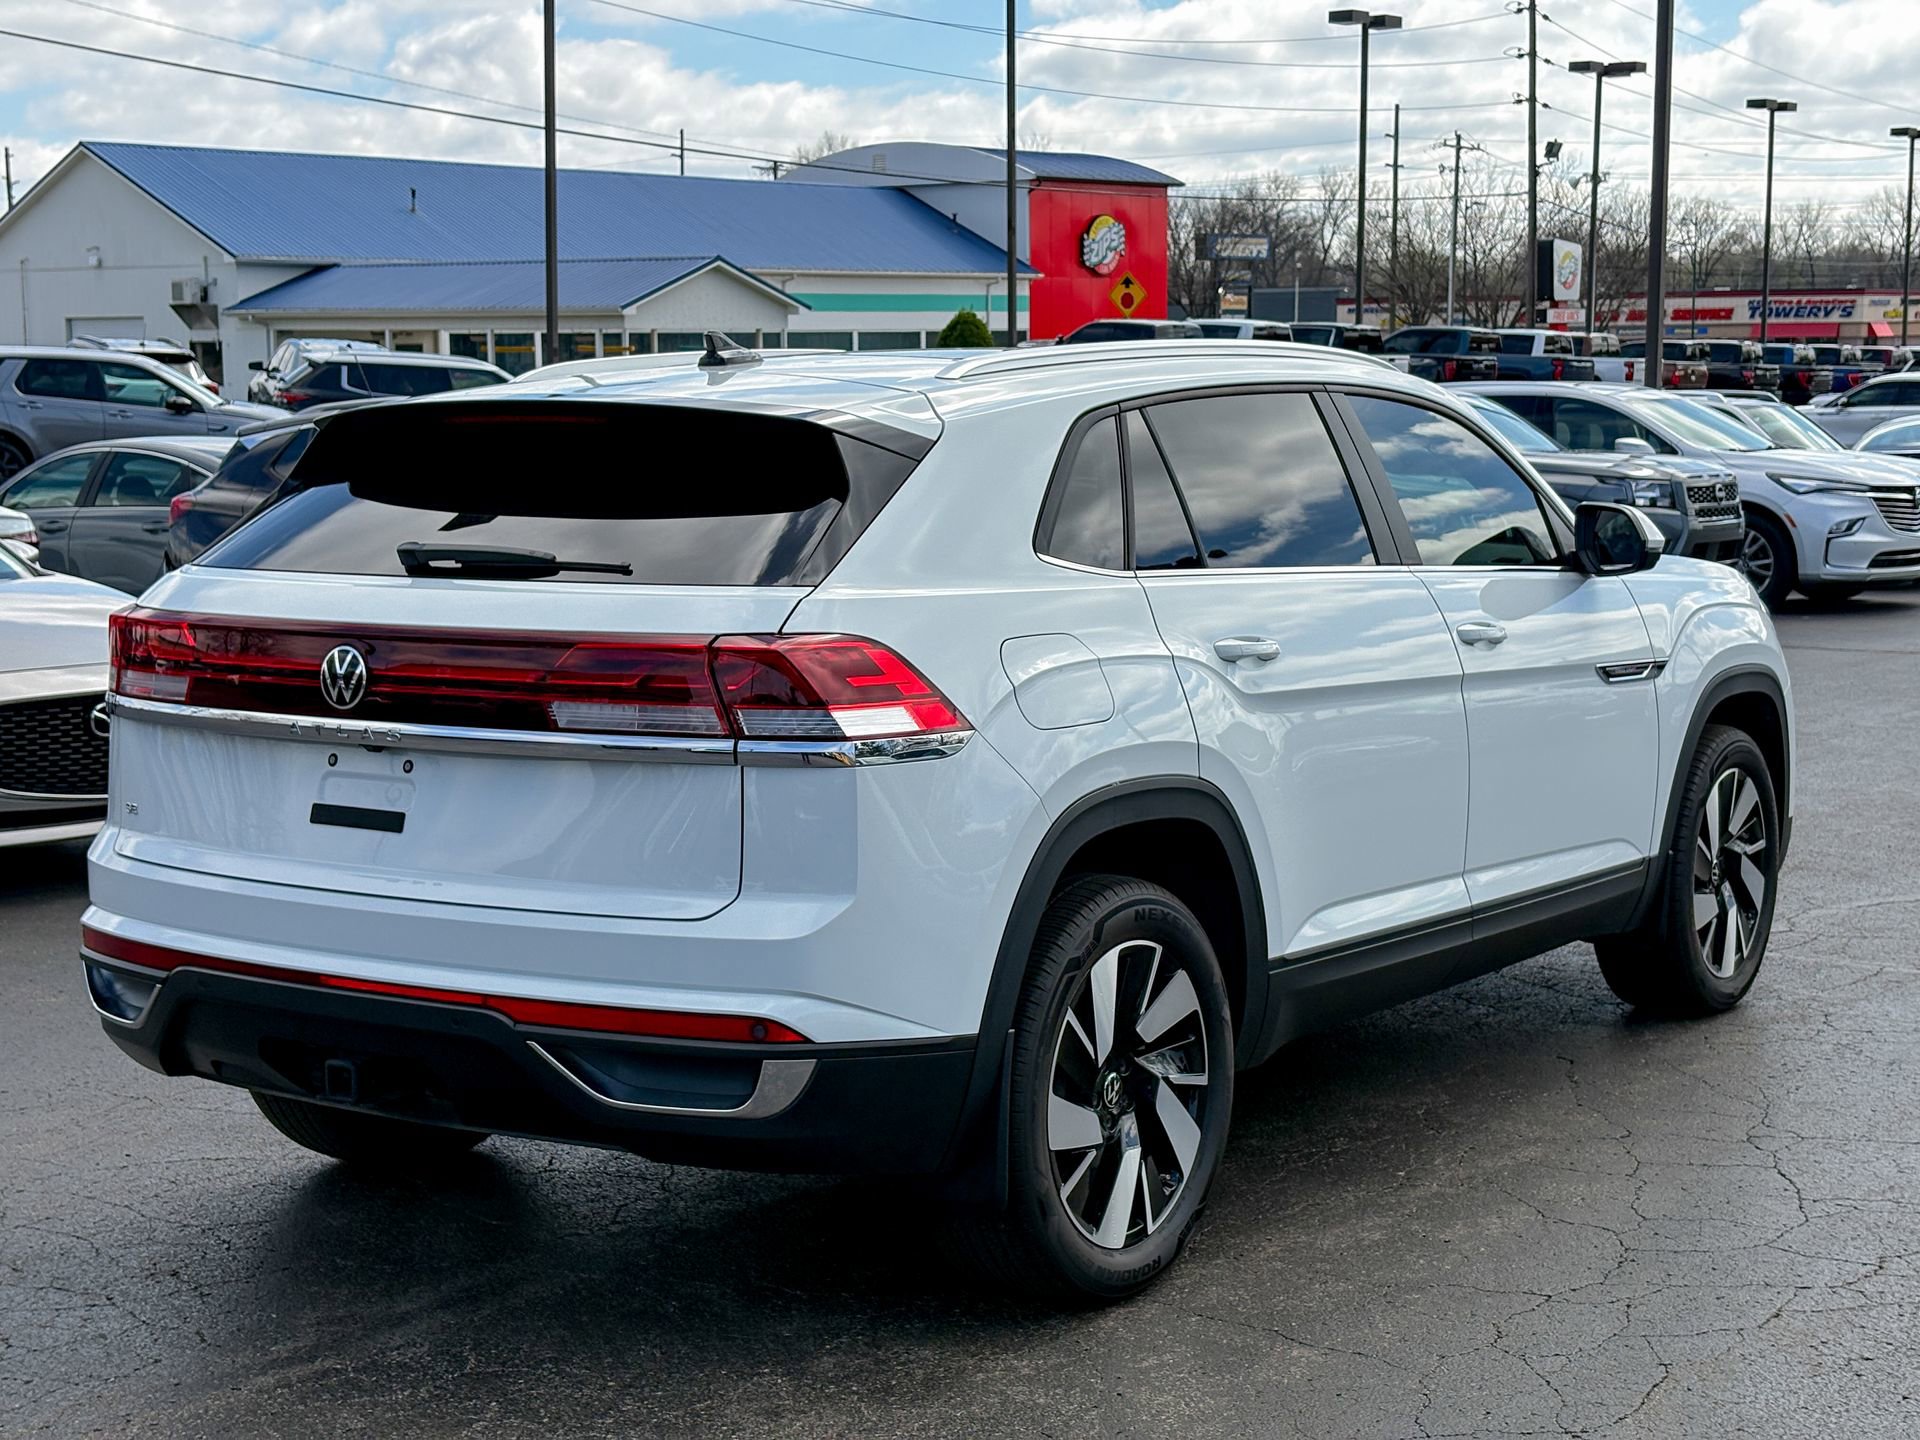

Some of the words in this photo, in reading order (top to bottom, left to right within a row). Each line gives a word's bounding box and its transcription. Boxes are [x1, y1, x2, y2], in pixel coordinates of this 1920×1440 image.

[1090, 226, 1120, 261] ZIPS
[1748, 305, 1855, 319] TOWERY'S
[322, 646, 365, 707] VW
[289, 720, 401, 743] ATLAS
